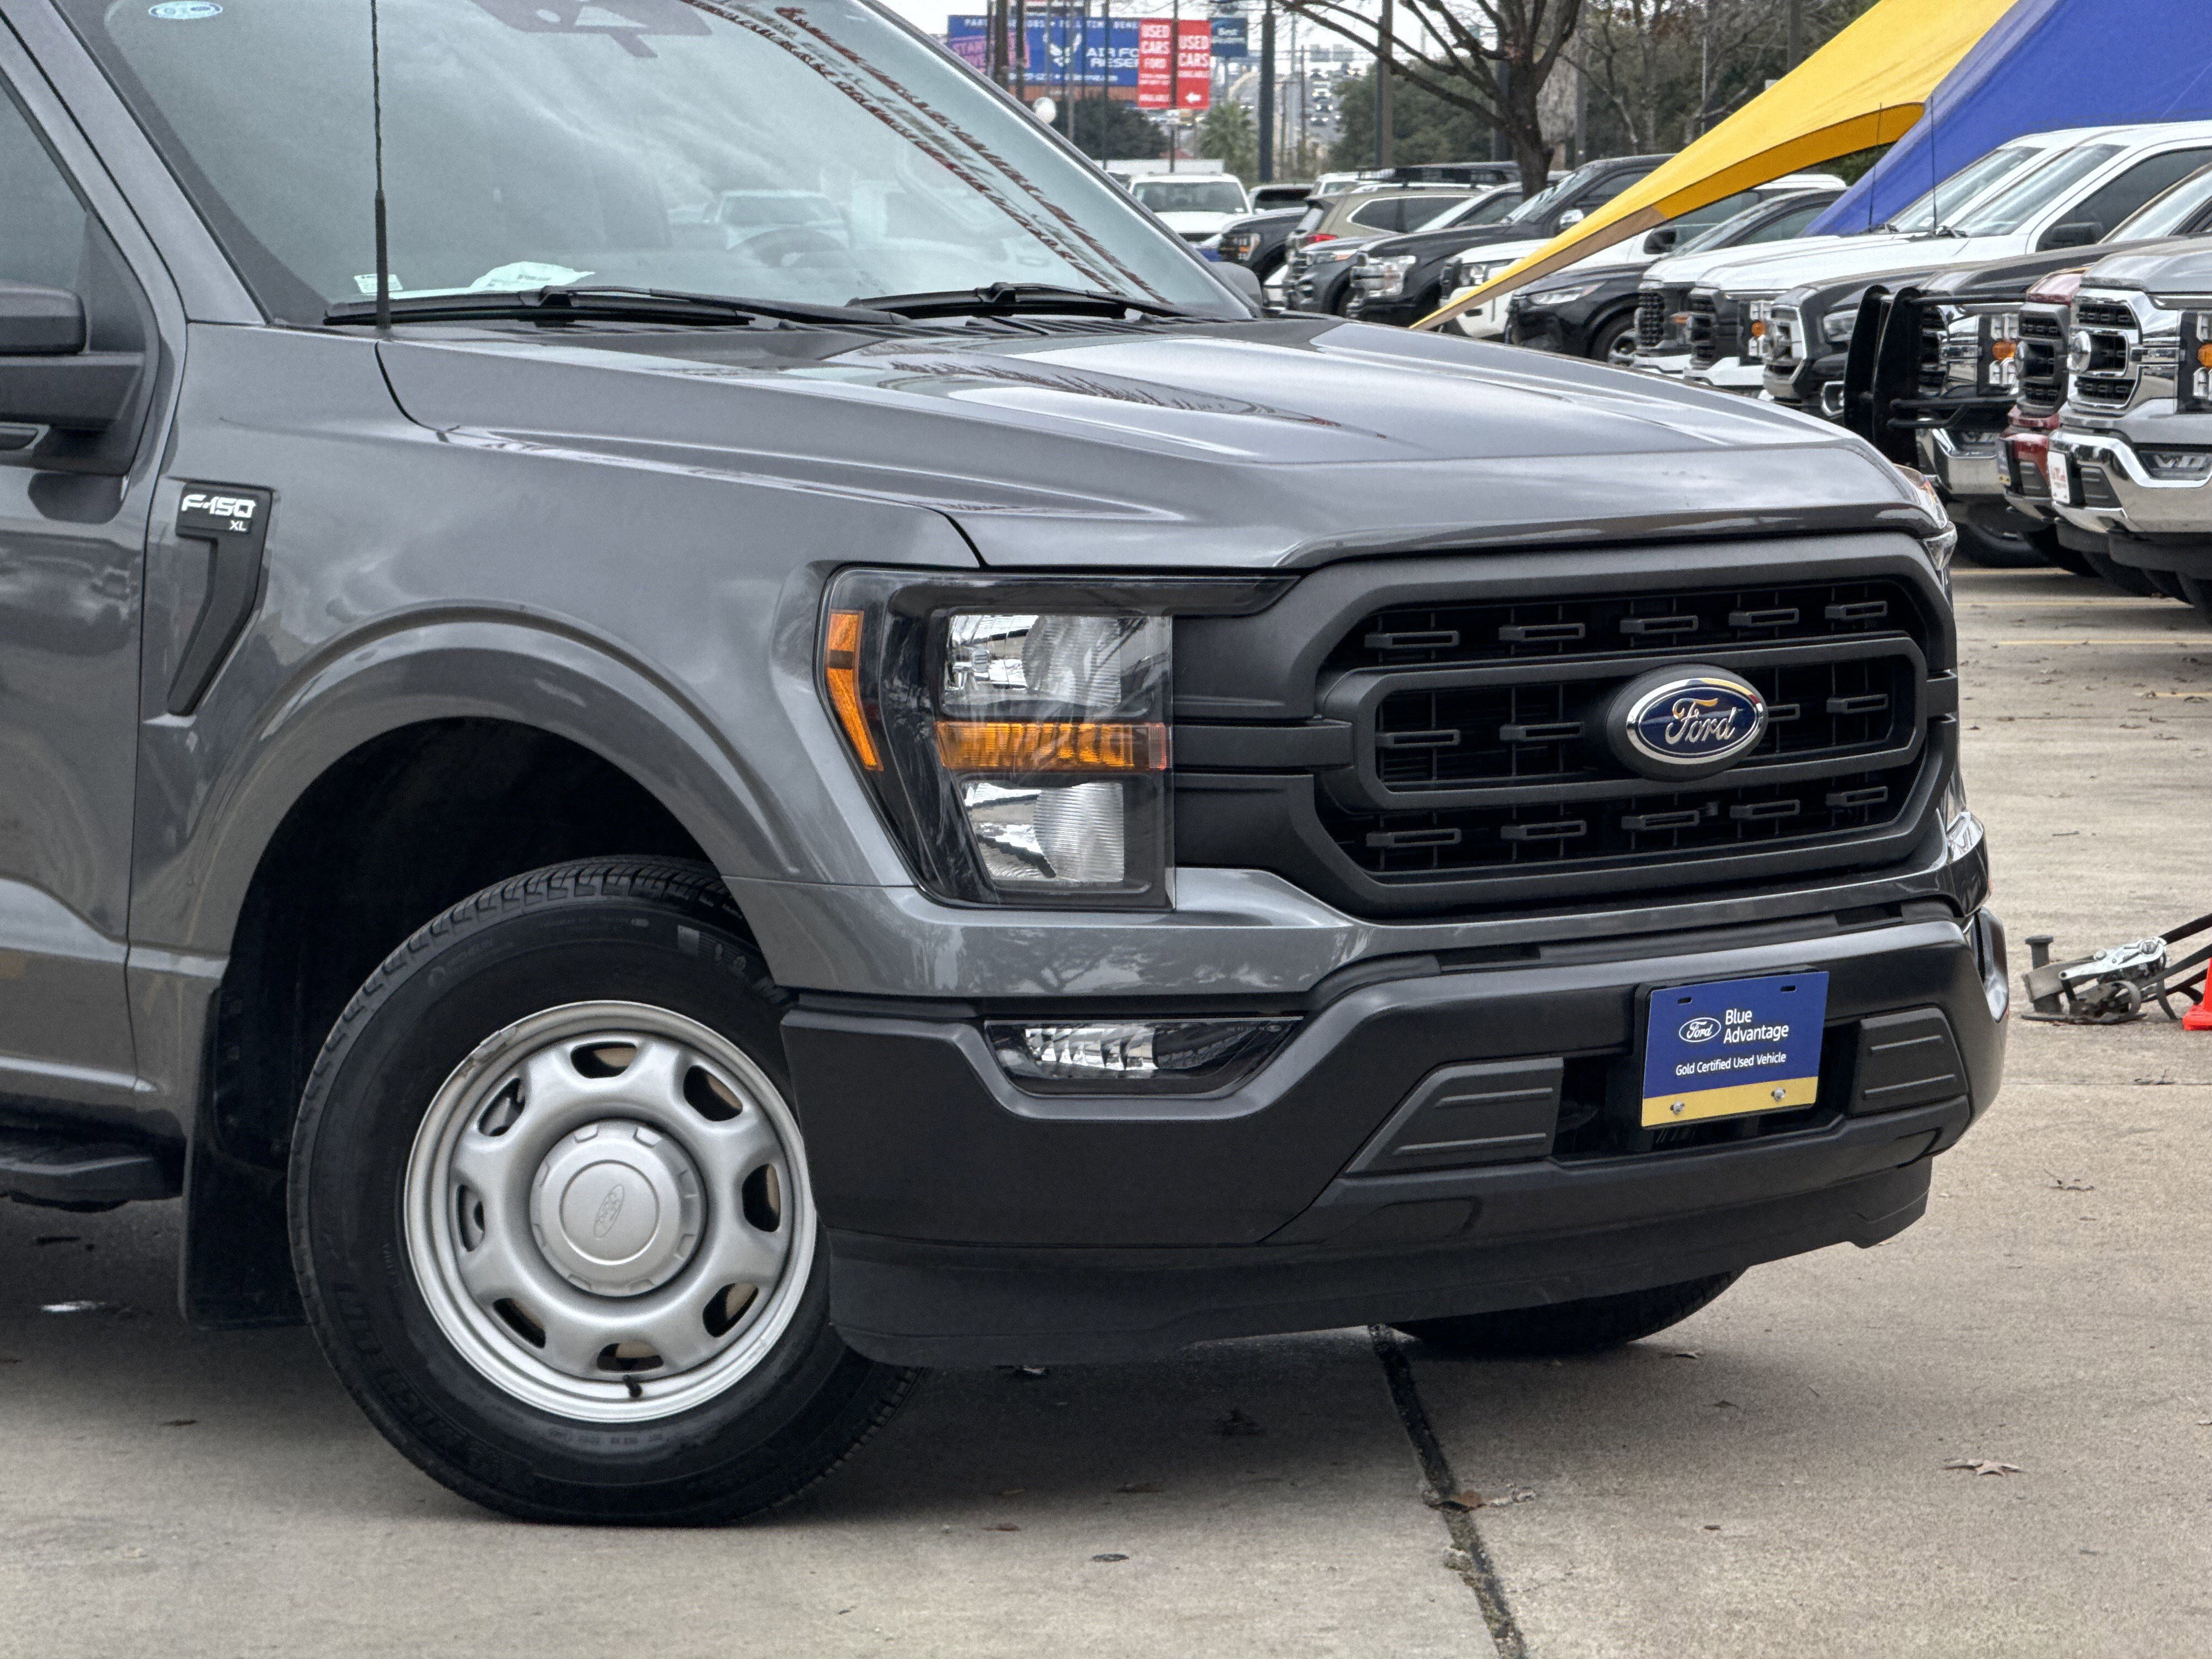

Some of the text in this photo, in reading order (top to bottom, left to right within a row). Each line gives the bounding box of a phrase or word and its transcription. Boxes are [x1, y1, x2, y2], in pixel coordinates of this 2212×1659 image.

[1142, 25, 1170, 38] USED
[1141, 41, 1170, 54] CARS
[1179, 36, 1210, 49] USED
[1178, 53, 1210, 67] CARS
[182, 494, 257, 518] F-150
[229, 520, 246, 532] XL
[1665, 697, 1737, 745] Ford
[1725, 1008, 1753, 1025] Blue
[1686, 1021, 1713, 1039] Ford
[1723, 1024, 1789, 1044] Advantage
[1675, 1052, 1786, 1076] Gold Certified Used Vehicle
